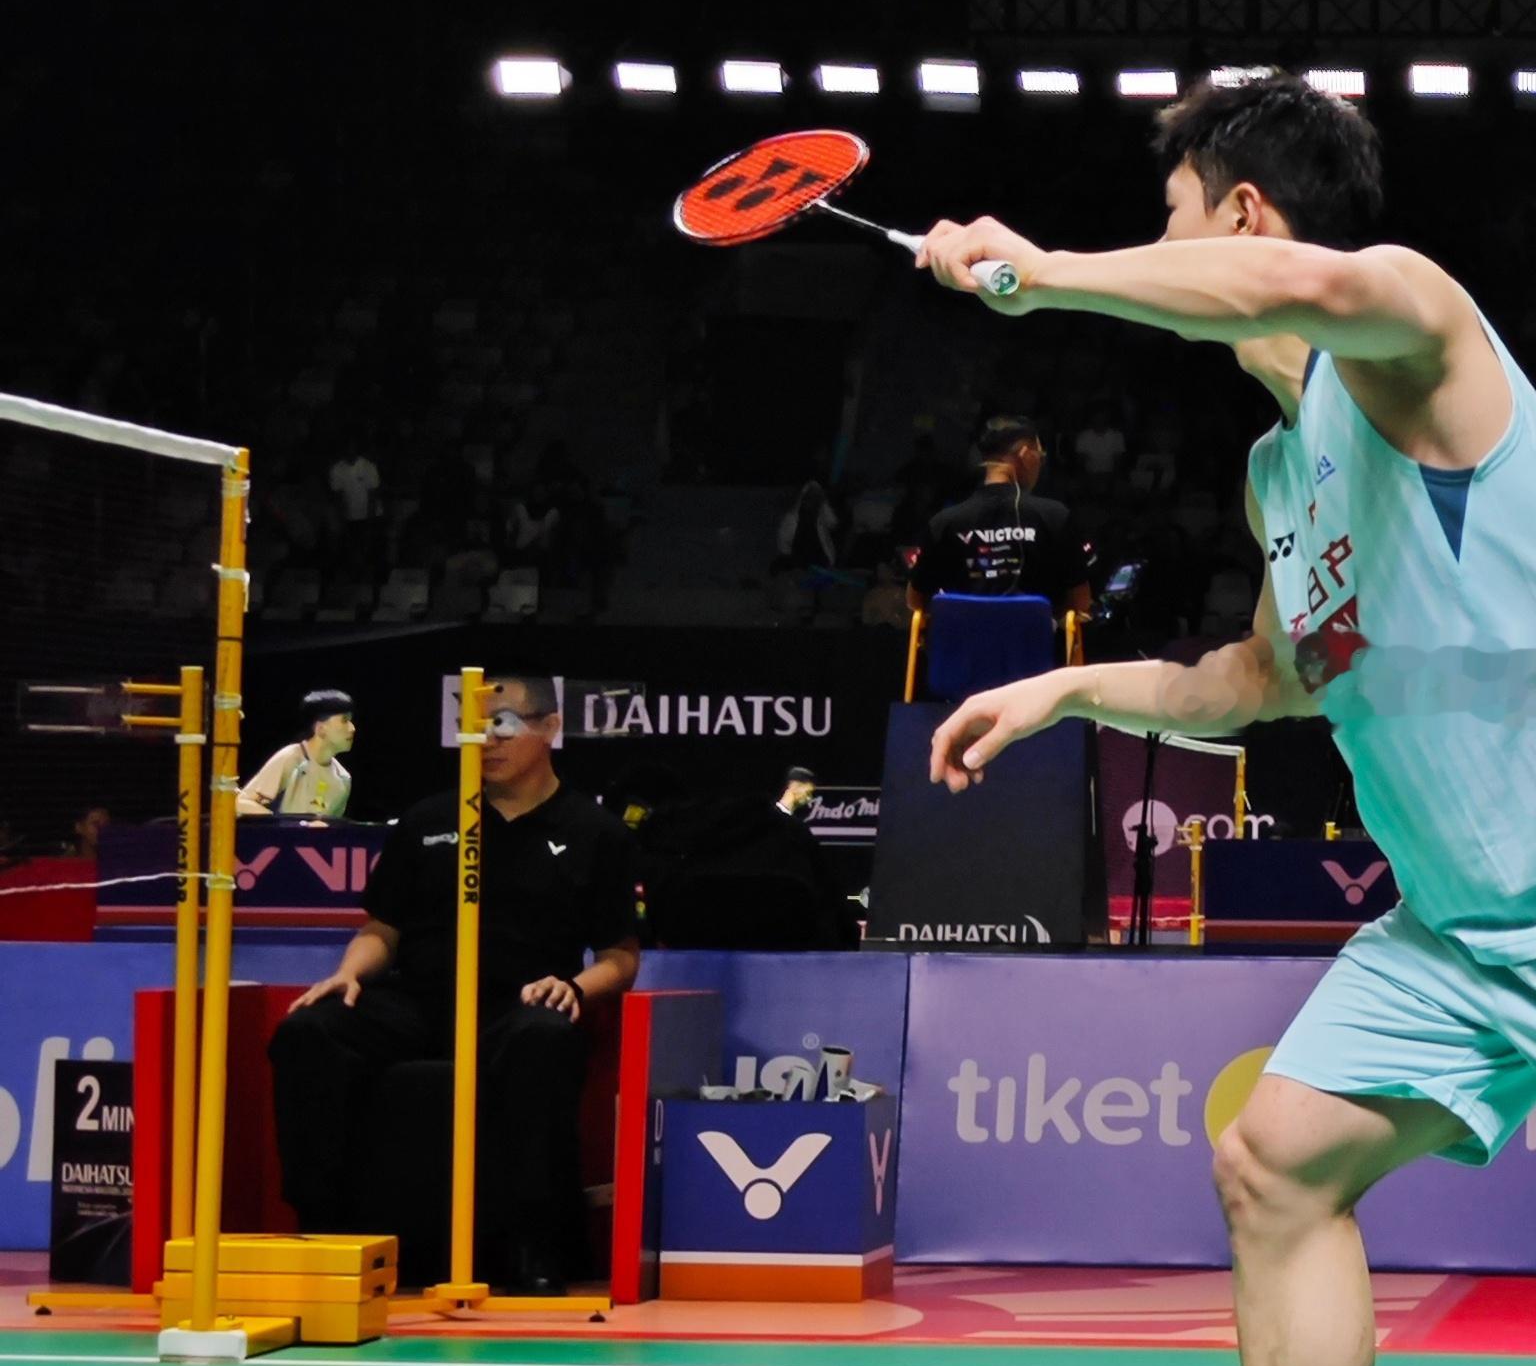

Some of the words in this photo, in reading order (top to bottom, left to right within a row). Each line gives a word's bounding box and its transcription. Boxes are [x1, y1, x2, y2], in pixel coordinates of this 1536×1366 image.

[976, 527, 1036, 543] VICTOR
[584, 694, 832, 737] DAIHATSU
[463, 822, 481, 905] VICTOR
[898, 921, 1028, 943] DAIHATSU
[76, 1075, 101, 1131] 2
[947, 1053, 1192, 1147] tiket
[62, 1162, 134, 1186] DAIHATSU
